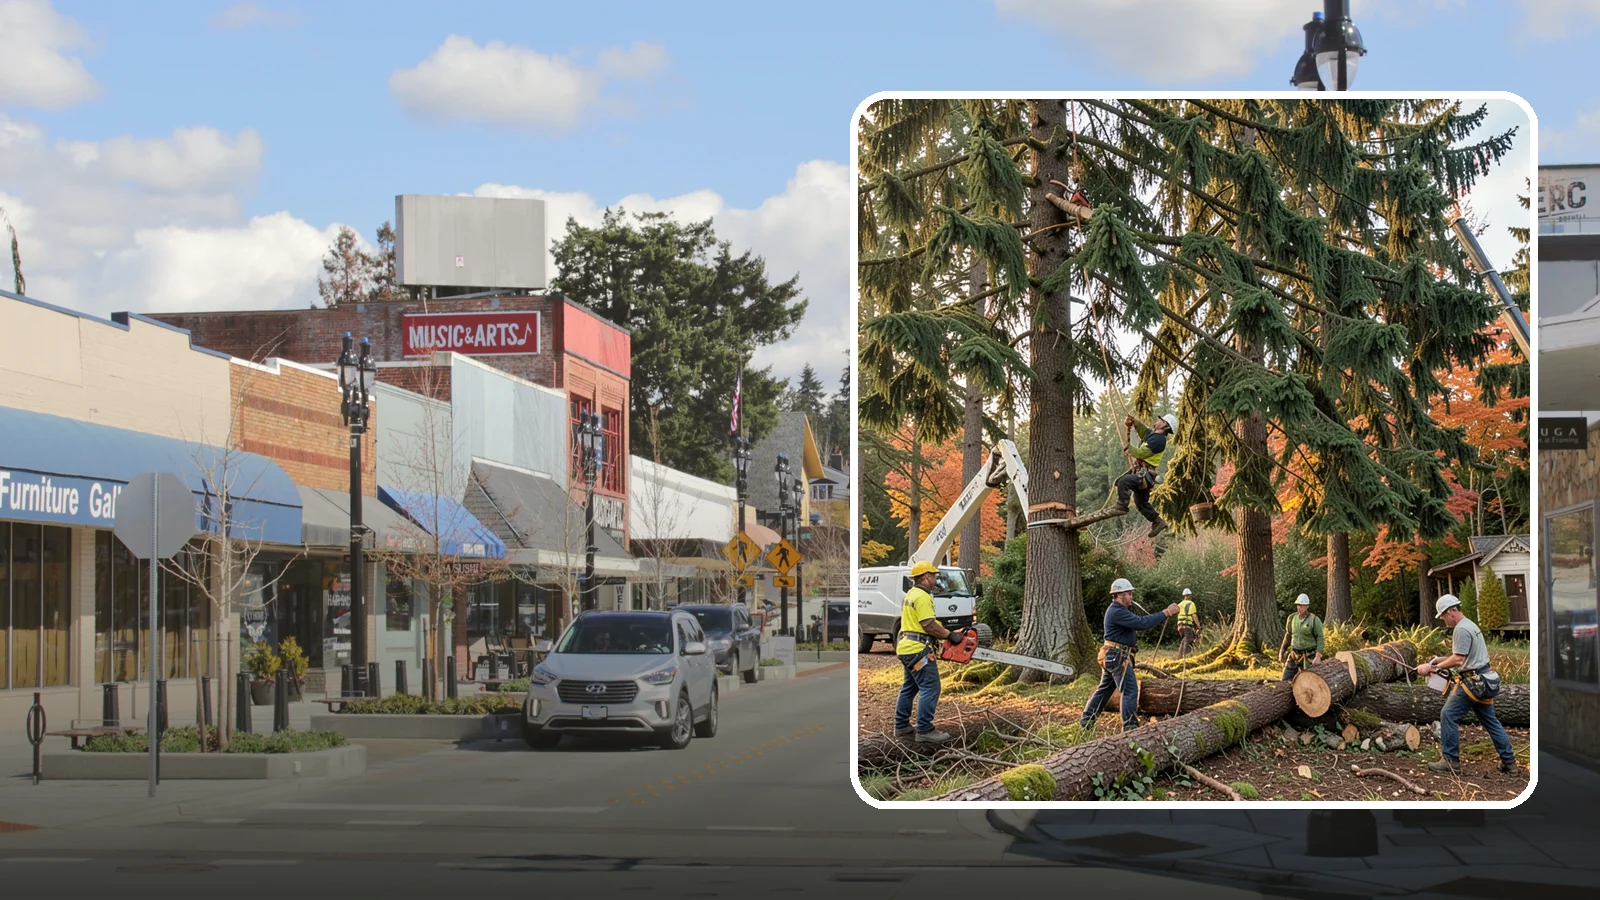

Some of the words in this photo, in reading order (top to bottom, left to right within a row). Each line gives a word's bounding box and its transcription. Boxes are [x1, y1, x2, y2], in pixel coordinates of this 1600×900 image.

[409, 323, 519, 349] MUSIC&ARTS
[1540, 428, 1577, 436] UGA
[0, 471, 79, 515] Furniture
